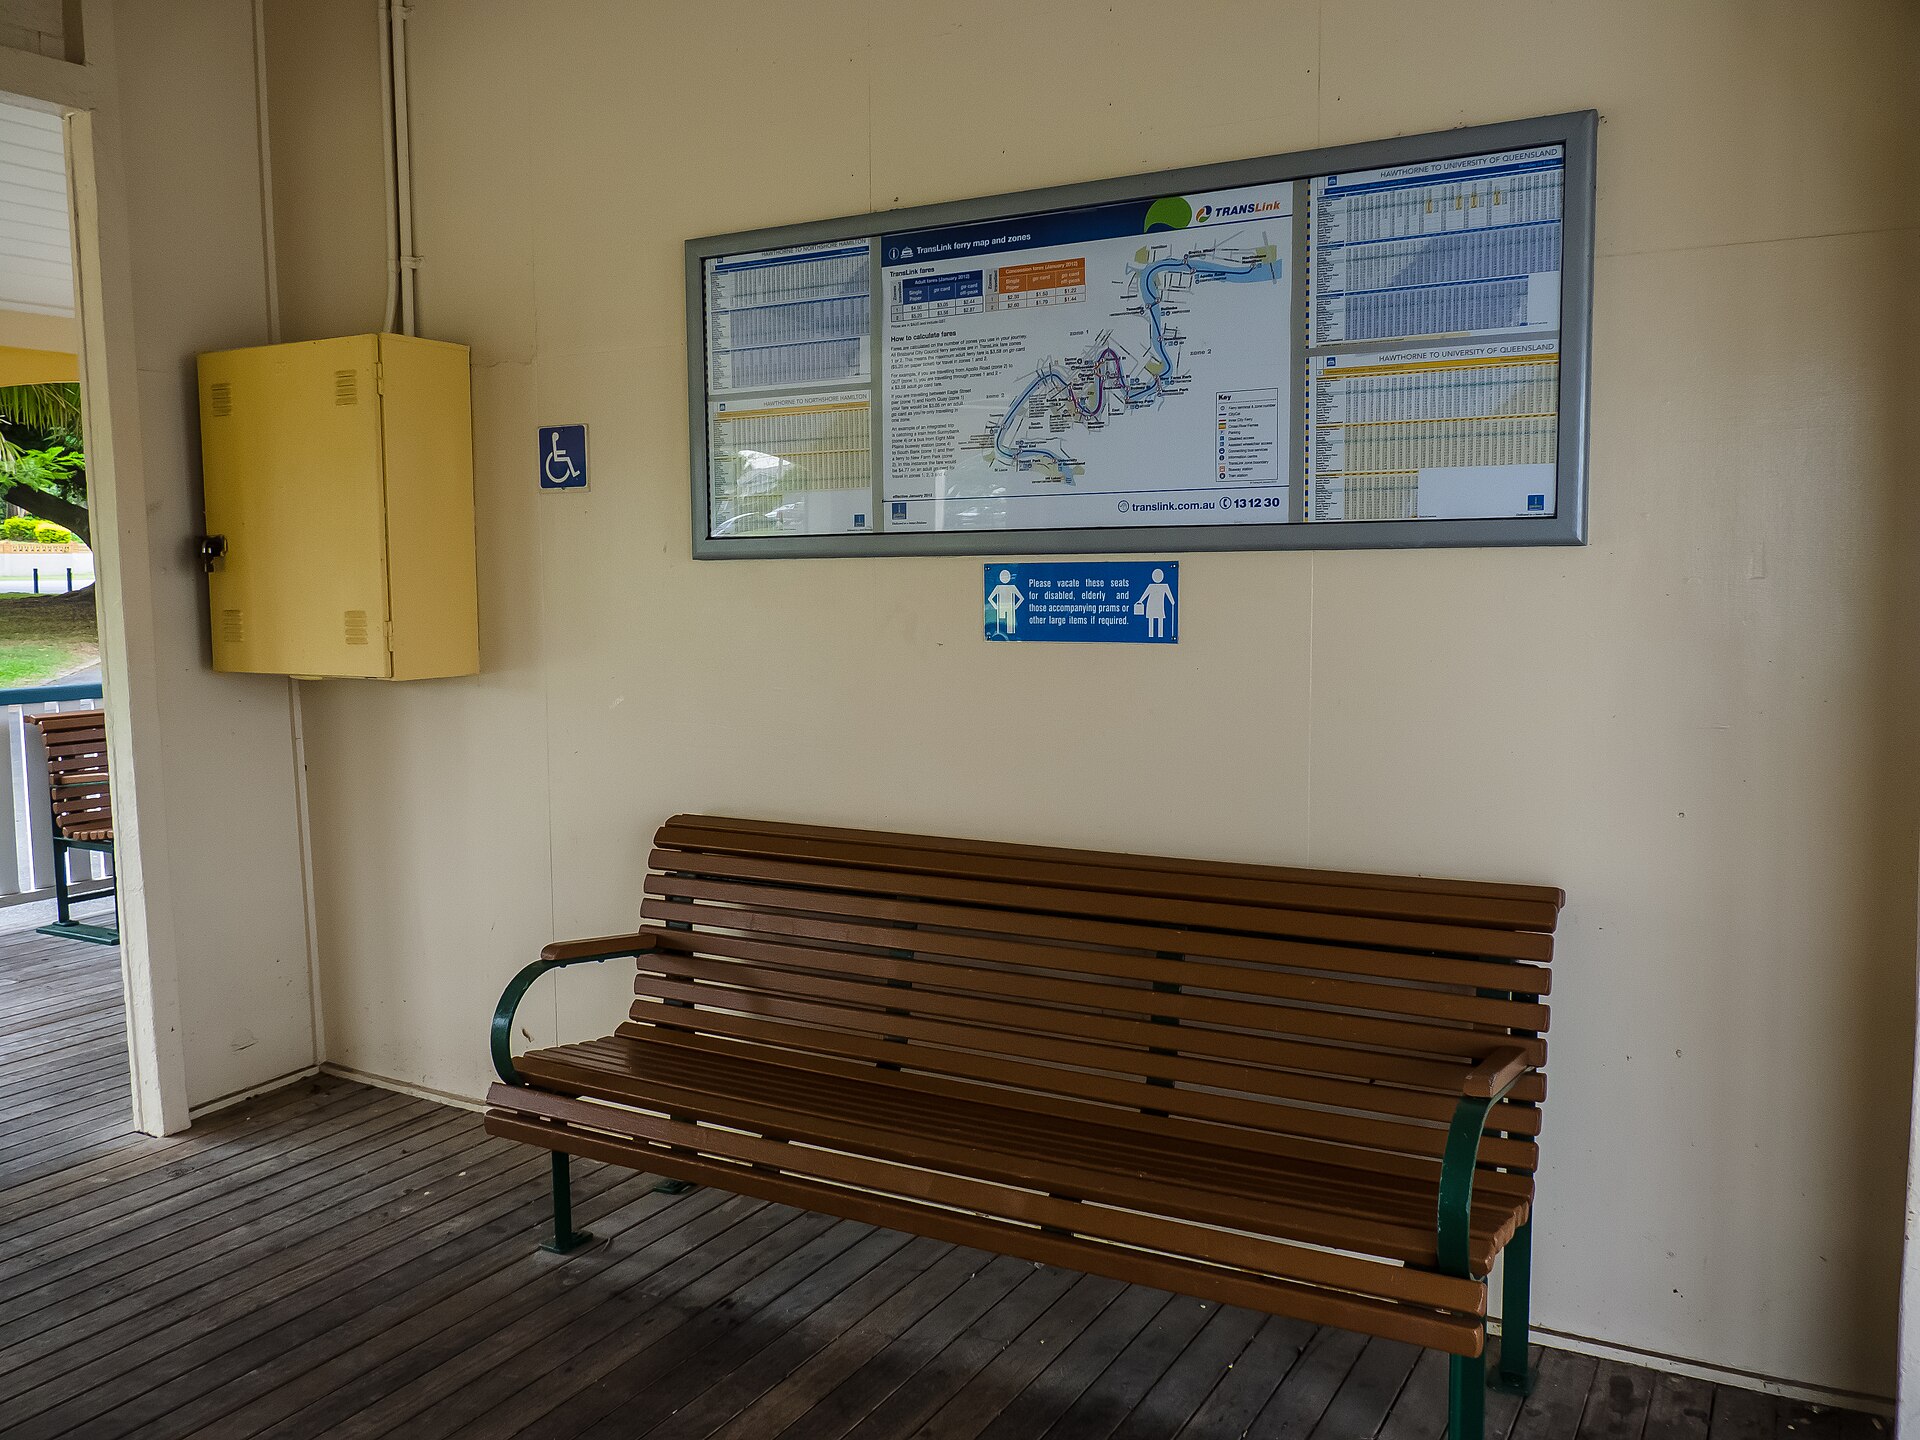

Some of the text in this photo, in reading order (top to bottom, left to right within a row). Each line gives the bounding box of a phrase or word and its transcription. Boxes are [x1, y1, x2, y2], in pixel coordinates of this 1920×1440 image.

[1381, 166, 1429, 178] HAWTHORNE
[1444, 157, 1487, 170] UNIVERSITY
[1489, 155, 1501, 163] OF
[1502, 149, 1557, 162] QUEENSLAND
[1215, 200, 1280, 217] TRANSLink
[917, 233, 1031, 254] TransLink ferry map and zones
[890, 266, 934, 278] TransLink fares
[939, 275, 957, 283] (January
[913, 332, 940, 340] calculate
[1379, 352, 1428, 362] HAWTHORNE
[1430, 351, 1440, 359] TO
[1441, 347, 1485, 358] UNIVERSITY
[1500, 343, 1554, 353] QUEENSLAND
[763, 398, 795, 407] HAWTHORNE
[805, 395, 839, 404] NORTHSHORE
[840, 393, 867, 401] HAMILTON
[1132, 500, 1215, 512] translink.com.au
[1234, 498, 1280, 508] 13 12 30
[1029, 578, 1129, 587] Please vacate these seats
[1029, 591, 1129, 601] for disabled, elderly and
[1029, 604, 1047, 612] those
[1048, 603, 1096, 614] accompanying
[1098, 605, 1120, 614] prams
[1029, 616, 1129, 626] other large items if required.
